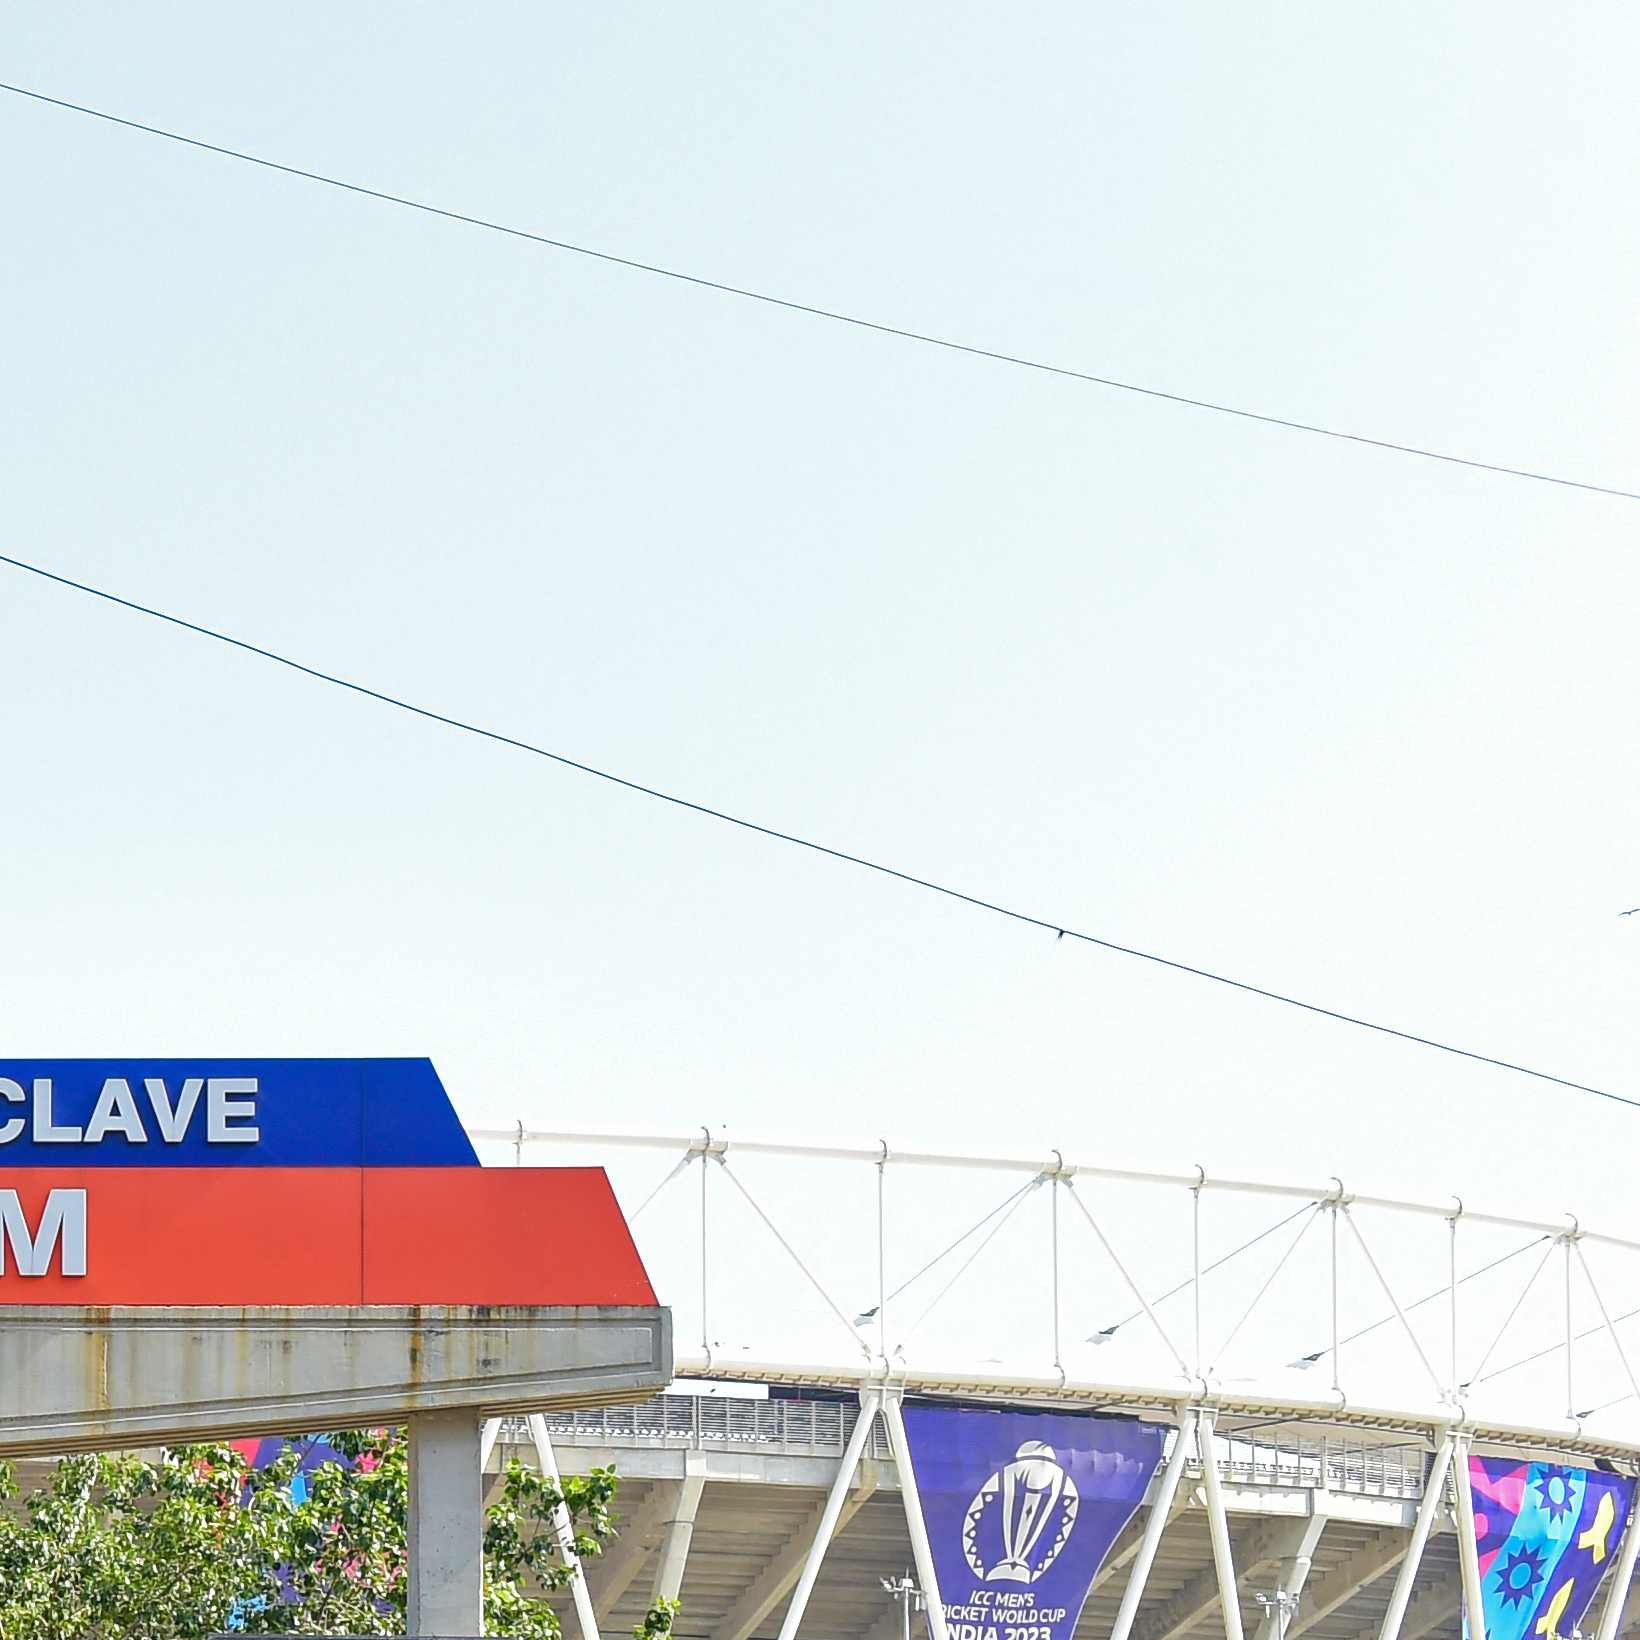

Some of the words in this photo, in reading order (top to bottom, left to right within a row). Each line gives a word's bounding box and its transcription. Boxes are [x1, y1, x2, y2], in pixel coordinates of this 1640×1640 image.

[969, 1590, 994, 1605] ICC
[995, 1592, 1035, 1608] MEN'S
[941, 1604, 989, 1622] RICKET
[1039, 1608, 1066, 1622] CUP
